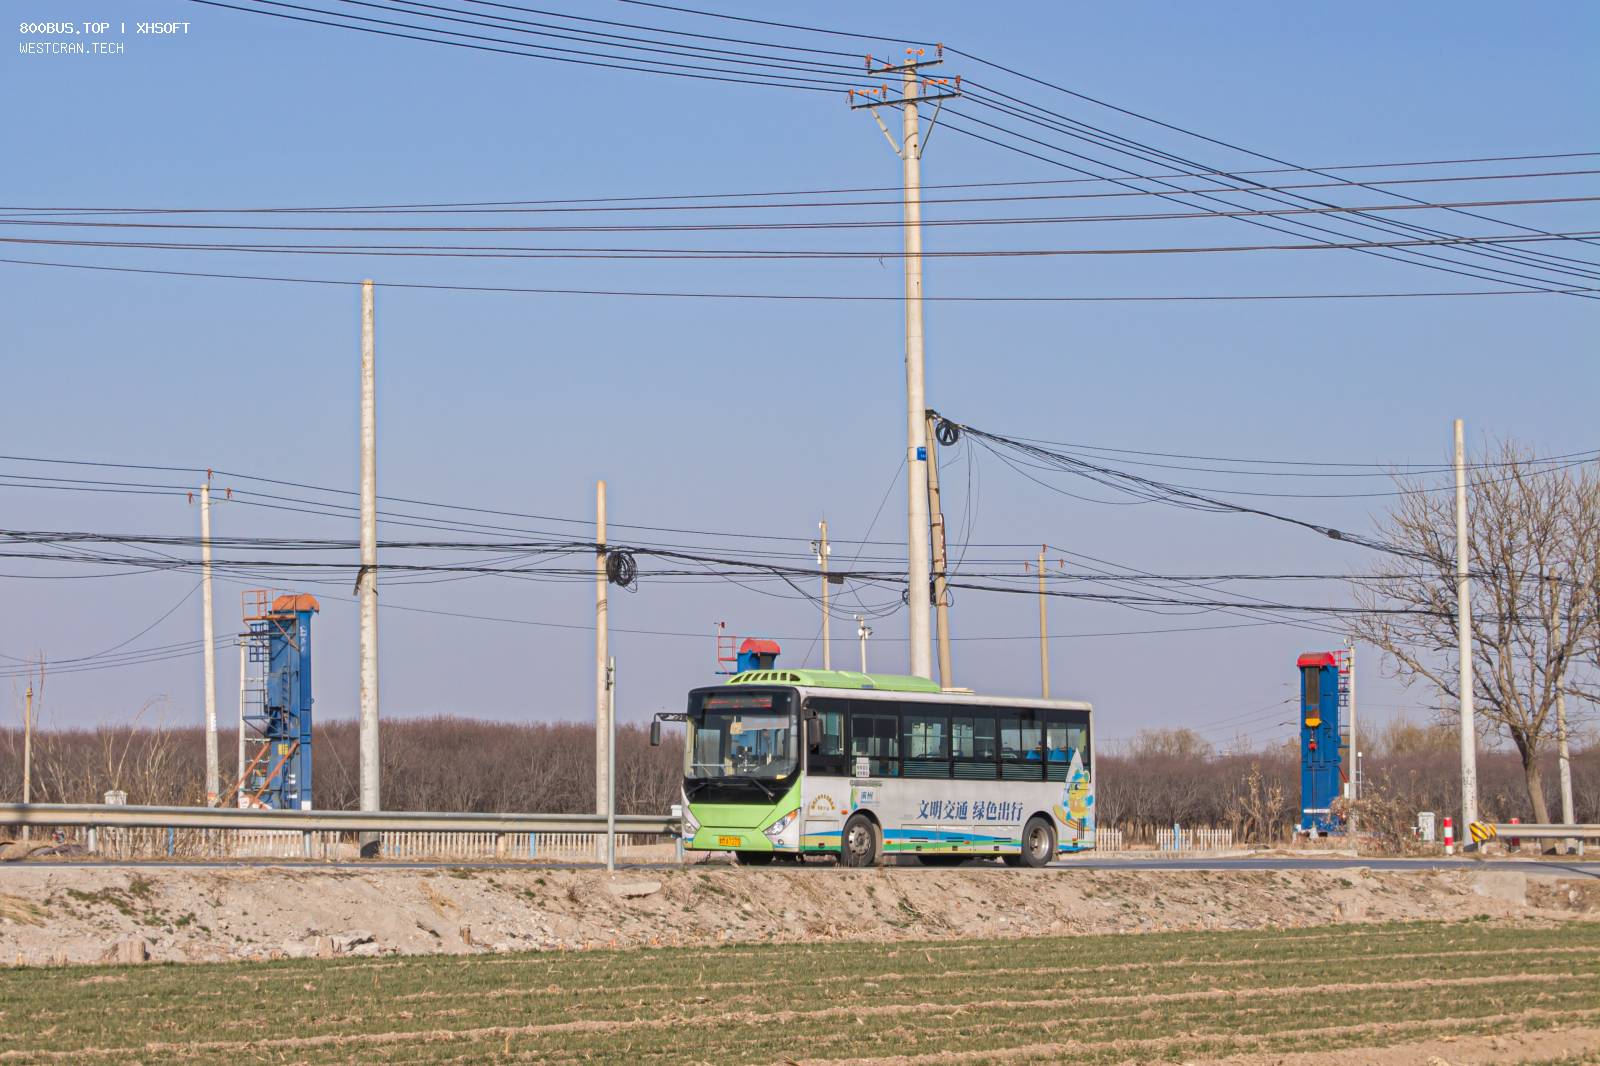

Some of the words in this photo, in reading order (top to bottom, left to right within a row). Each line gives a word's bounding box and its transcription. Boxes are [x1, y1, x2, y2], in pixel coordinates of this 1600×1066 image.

[917, 799, 968, 820] 文明交通
[972, 800, 1023, 821] 绿色出行
